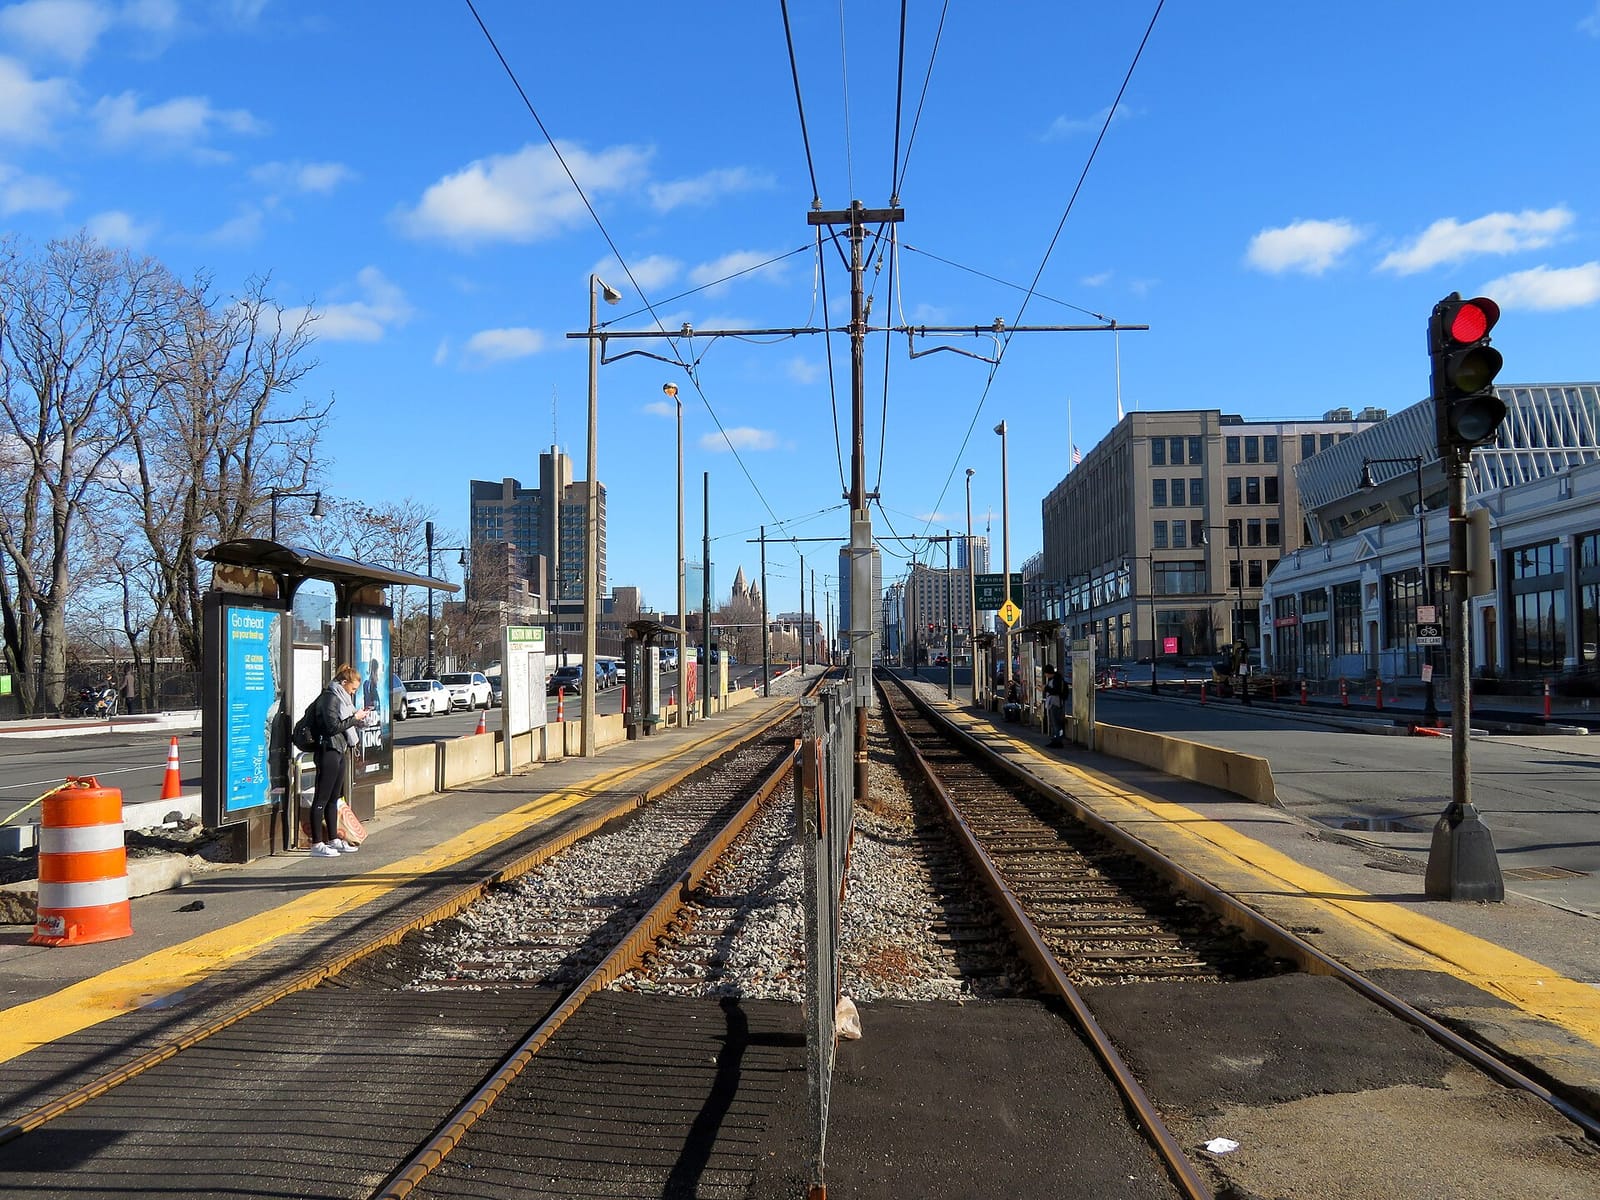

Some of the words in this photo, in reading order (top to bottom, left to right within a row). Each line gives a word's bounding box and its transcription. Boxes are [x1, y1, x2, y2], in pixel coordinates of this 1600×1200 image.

[232, 614, 242, 627] Go
[244, 616, 264, 628] ahead
[362, 730, 382, 752] KING
